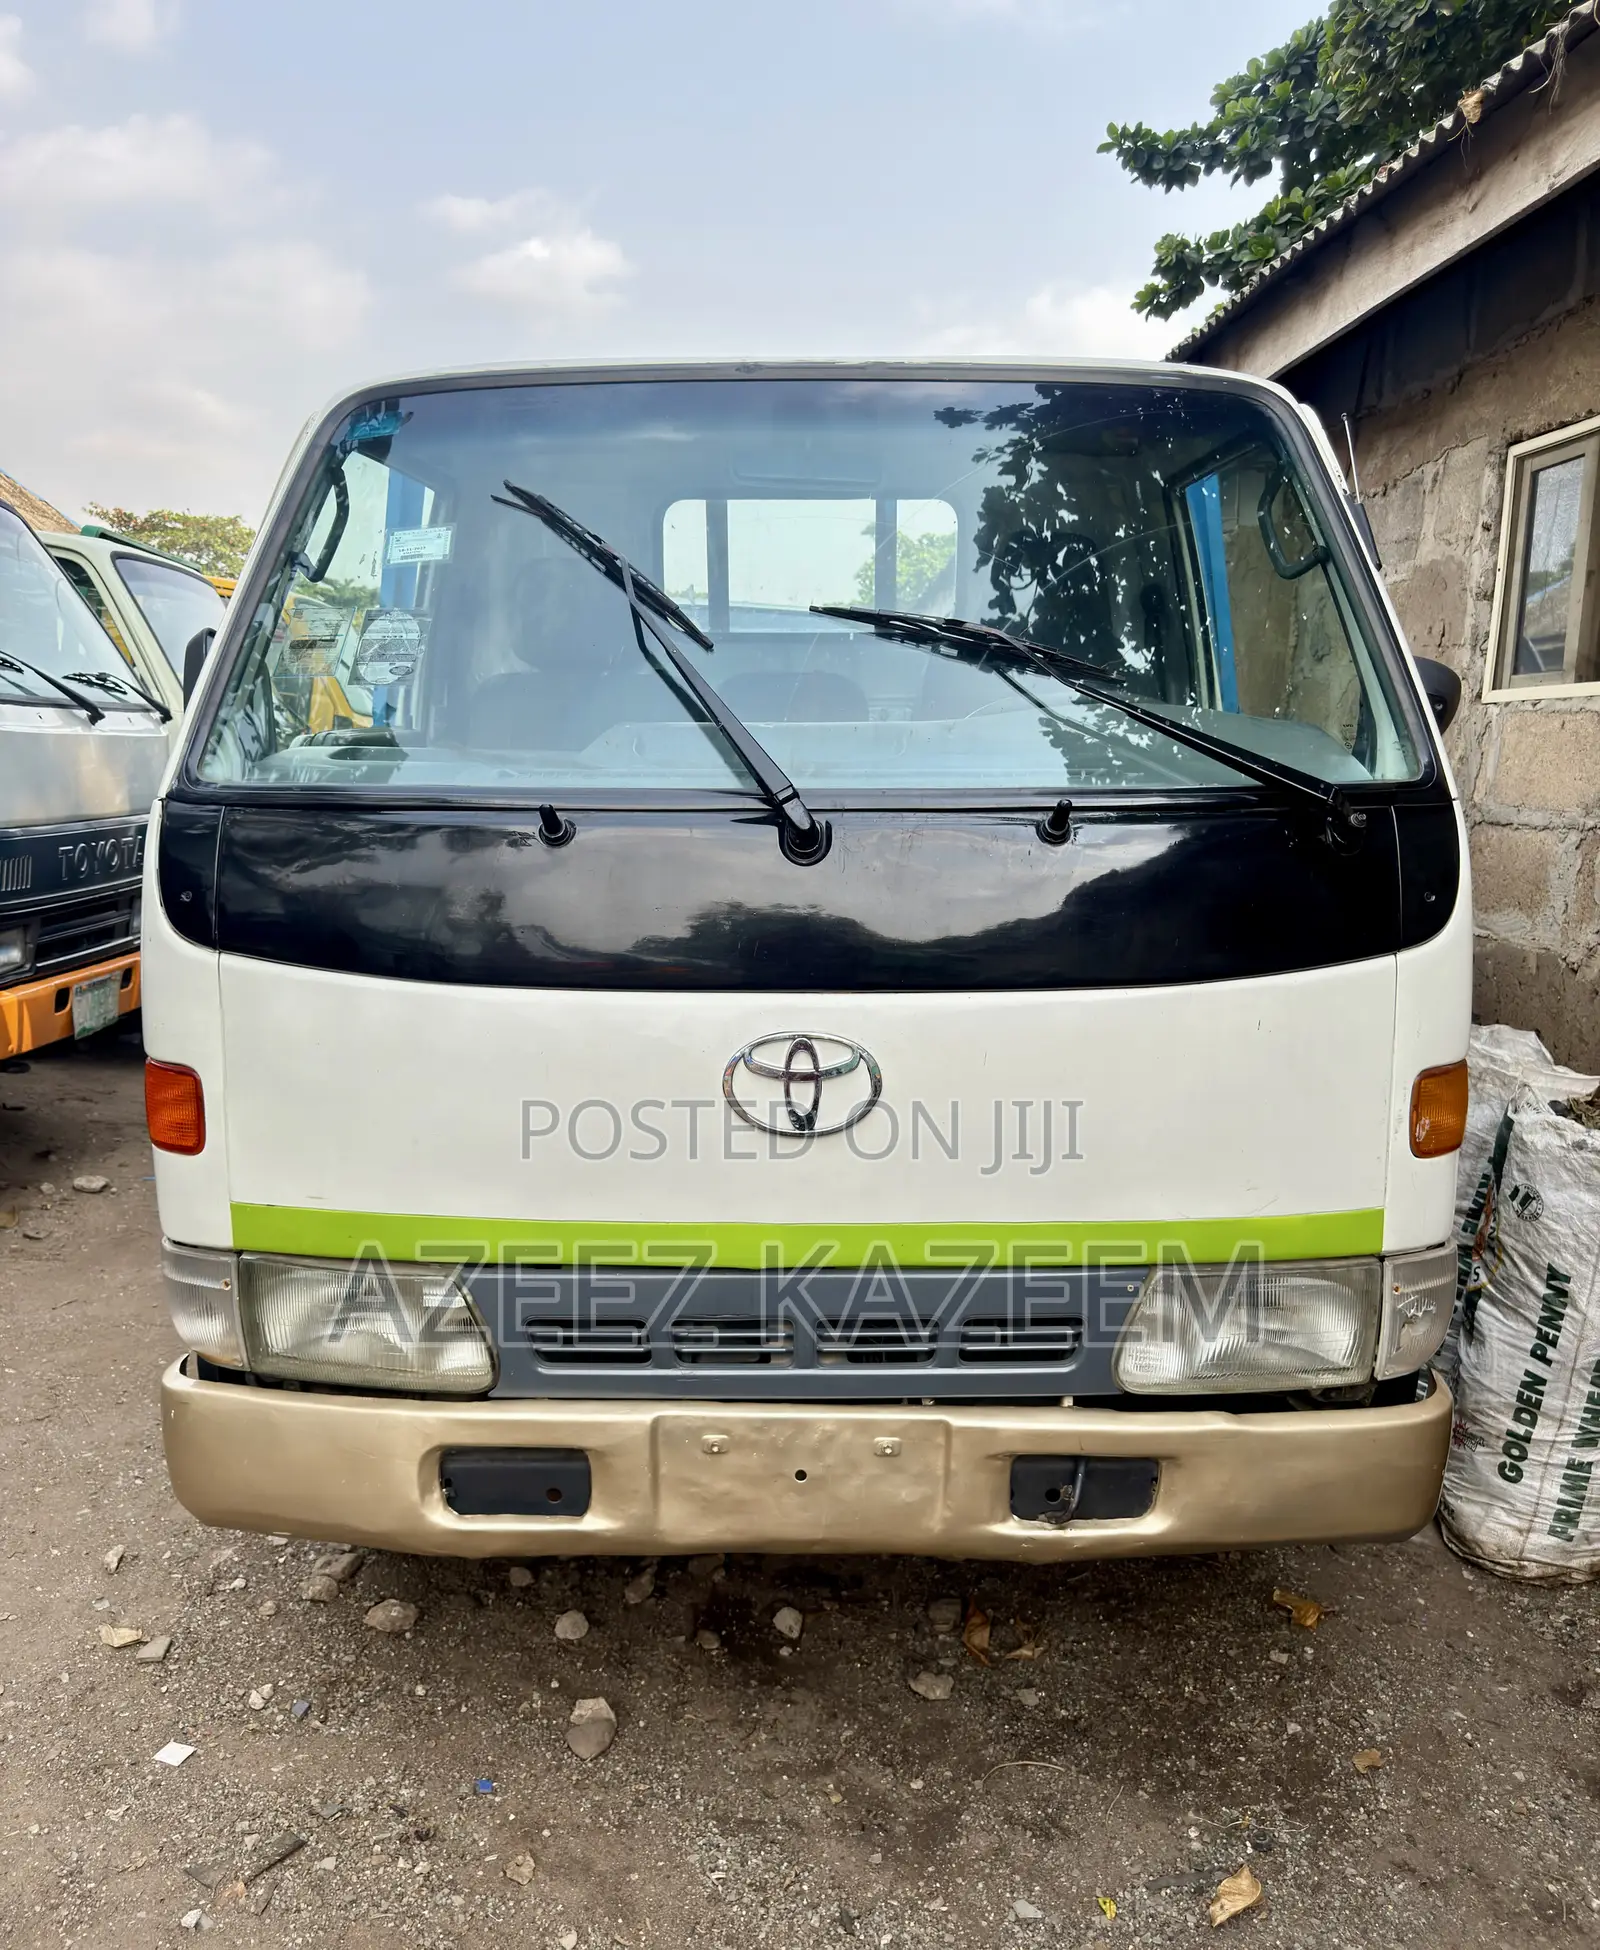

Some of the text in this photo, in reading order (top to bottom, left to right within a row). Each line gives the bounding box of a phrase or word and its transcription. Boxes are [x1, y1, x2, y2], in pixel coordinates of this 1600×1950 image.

[58, 836, 144, 881] TOYOTA
[1497, 1262, 1571, 1484] GOLDEN PENNY
[1547, 1456, 1594, 1542] PRIME
